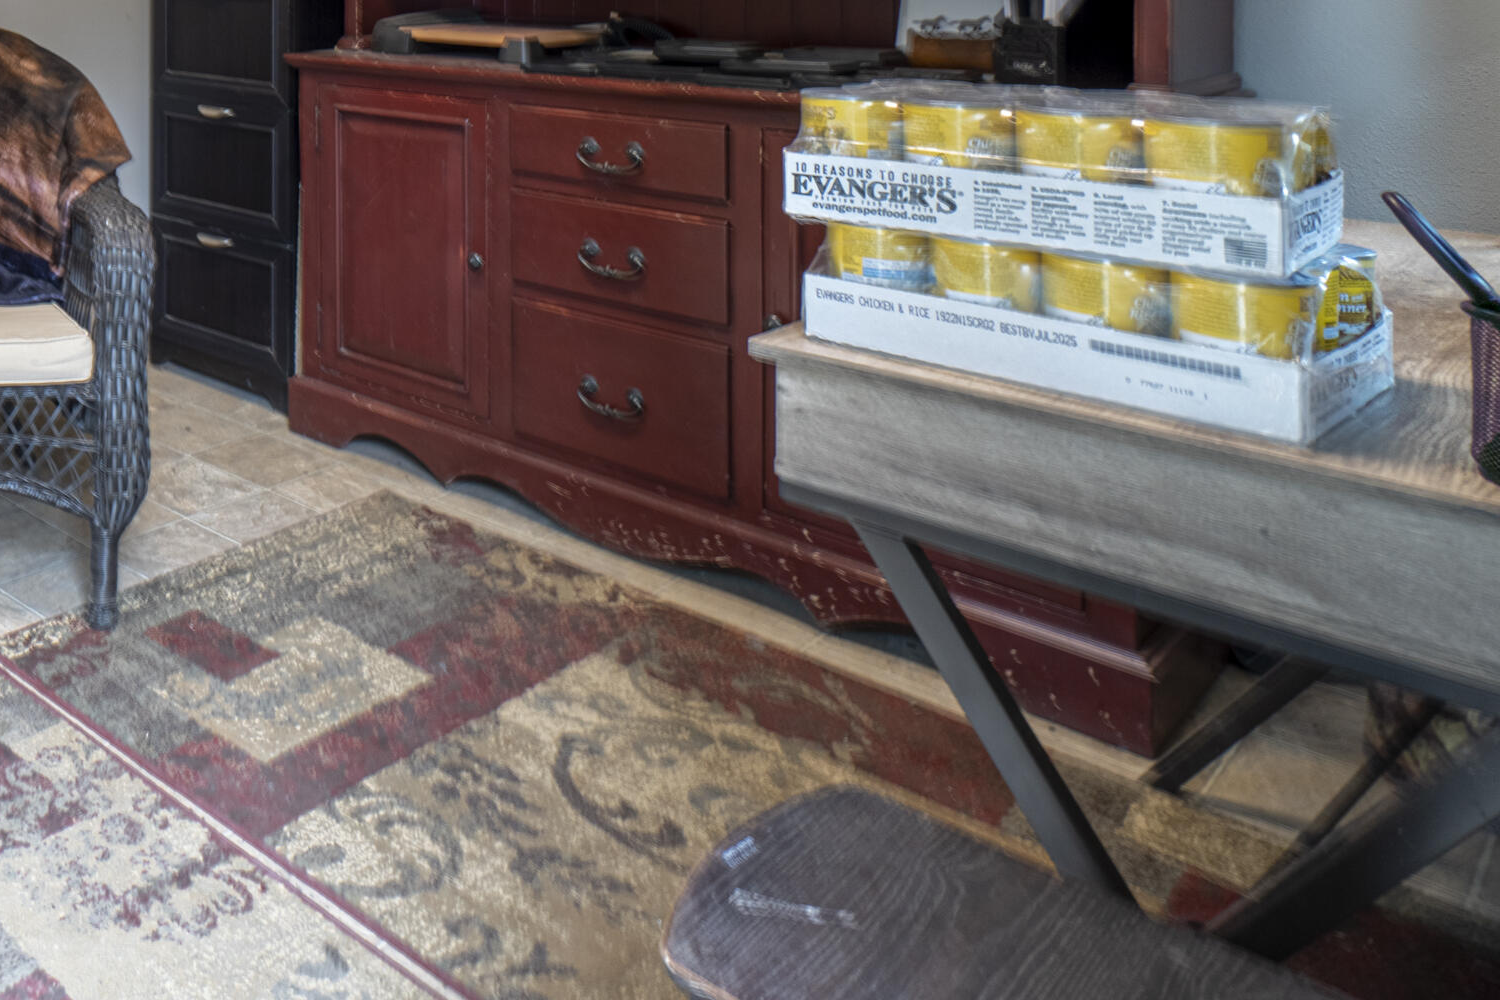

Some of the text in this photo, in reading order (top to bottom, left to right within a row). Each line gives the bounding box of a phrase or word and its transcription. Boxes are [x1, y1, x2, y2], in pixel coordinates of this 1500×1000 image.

[795, 162, 952, 188] 10 REASONS TO CHOOSE
[791, 172, 959, 215] EVANGER'S
[812, 202, 937, 224] evangerspetfood.com
[816, 288, 855, 305] EVANGERS
[859, 296, 895, 312] CHICKEN
[898, 303, 904, 314] &
[908, 305, 930, 319] RICE
